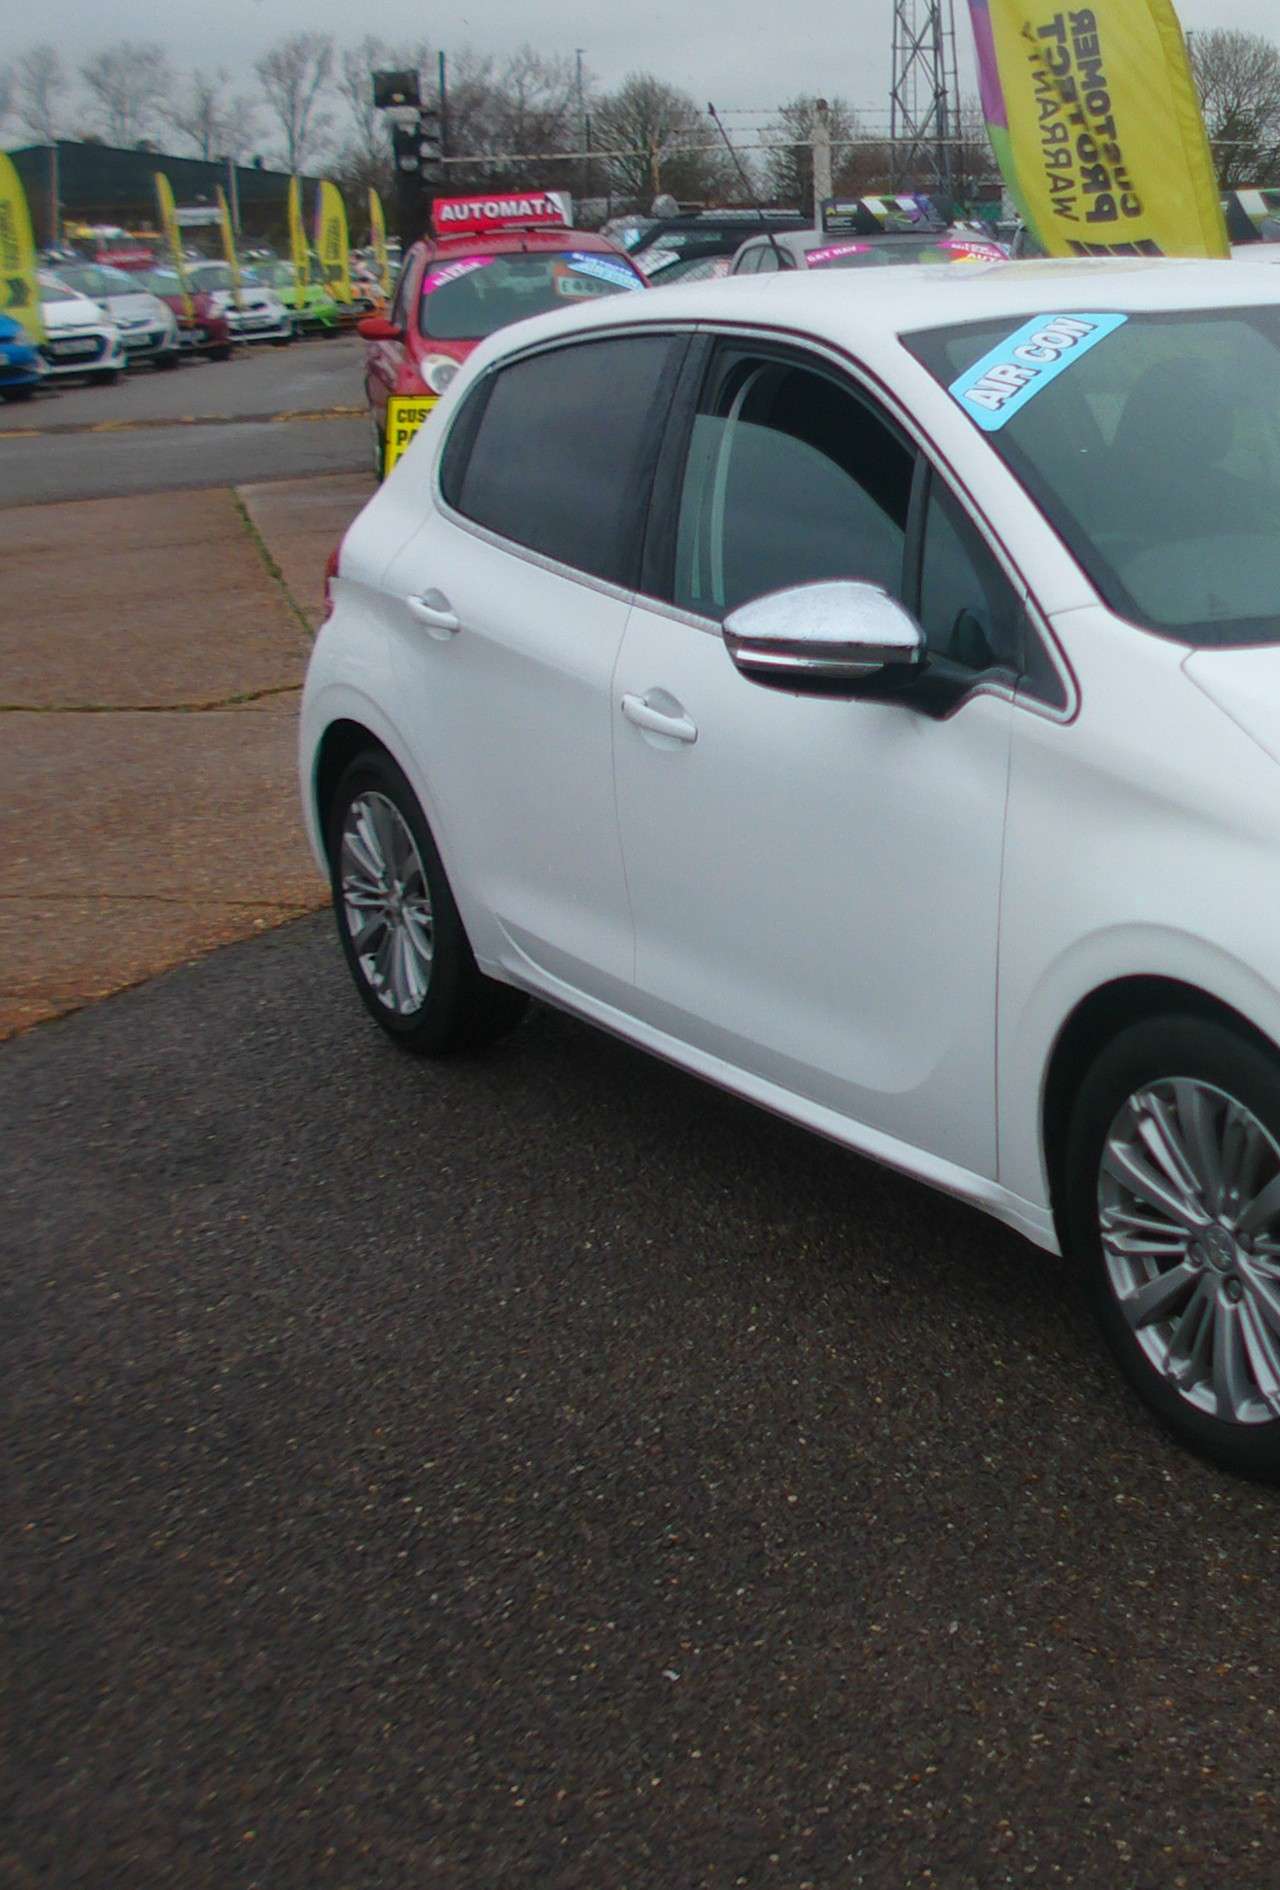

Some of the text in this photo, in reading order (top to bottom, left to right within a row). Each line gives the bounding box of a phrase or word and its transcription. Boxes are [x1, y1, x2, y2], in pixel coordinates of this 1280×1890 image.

[963, 315, 1099, 412] AIR CON
[397, 408, 432, 424] CUS
